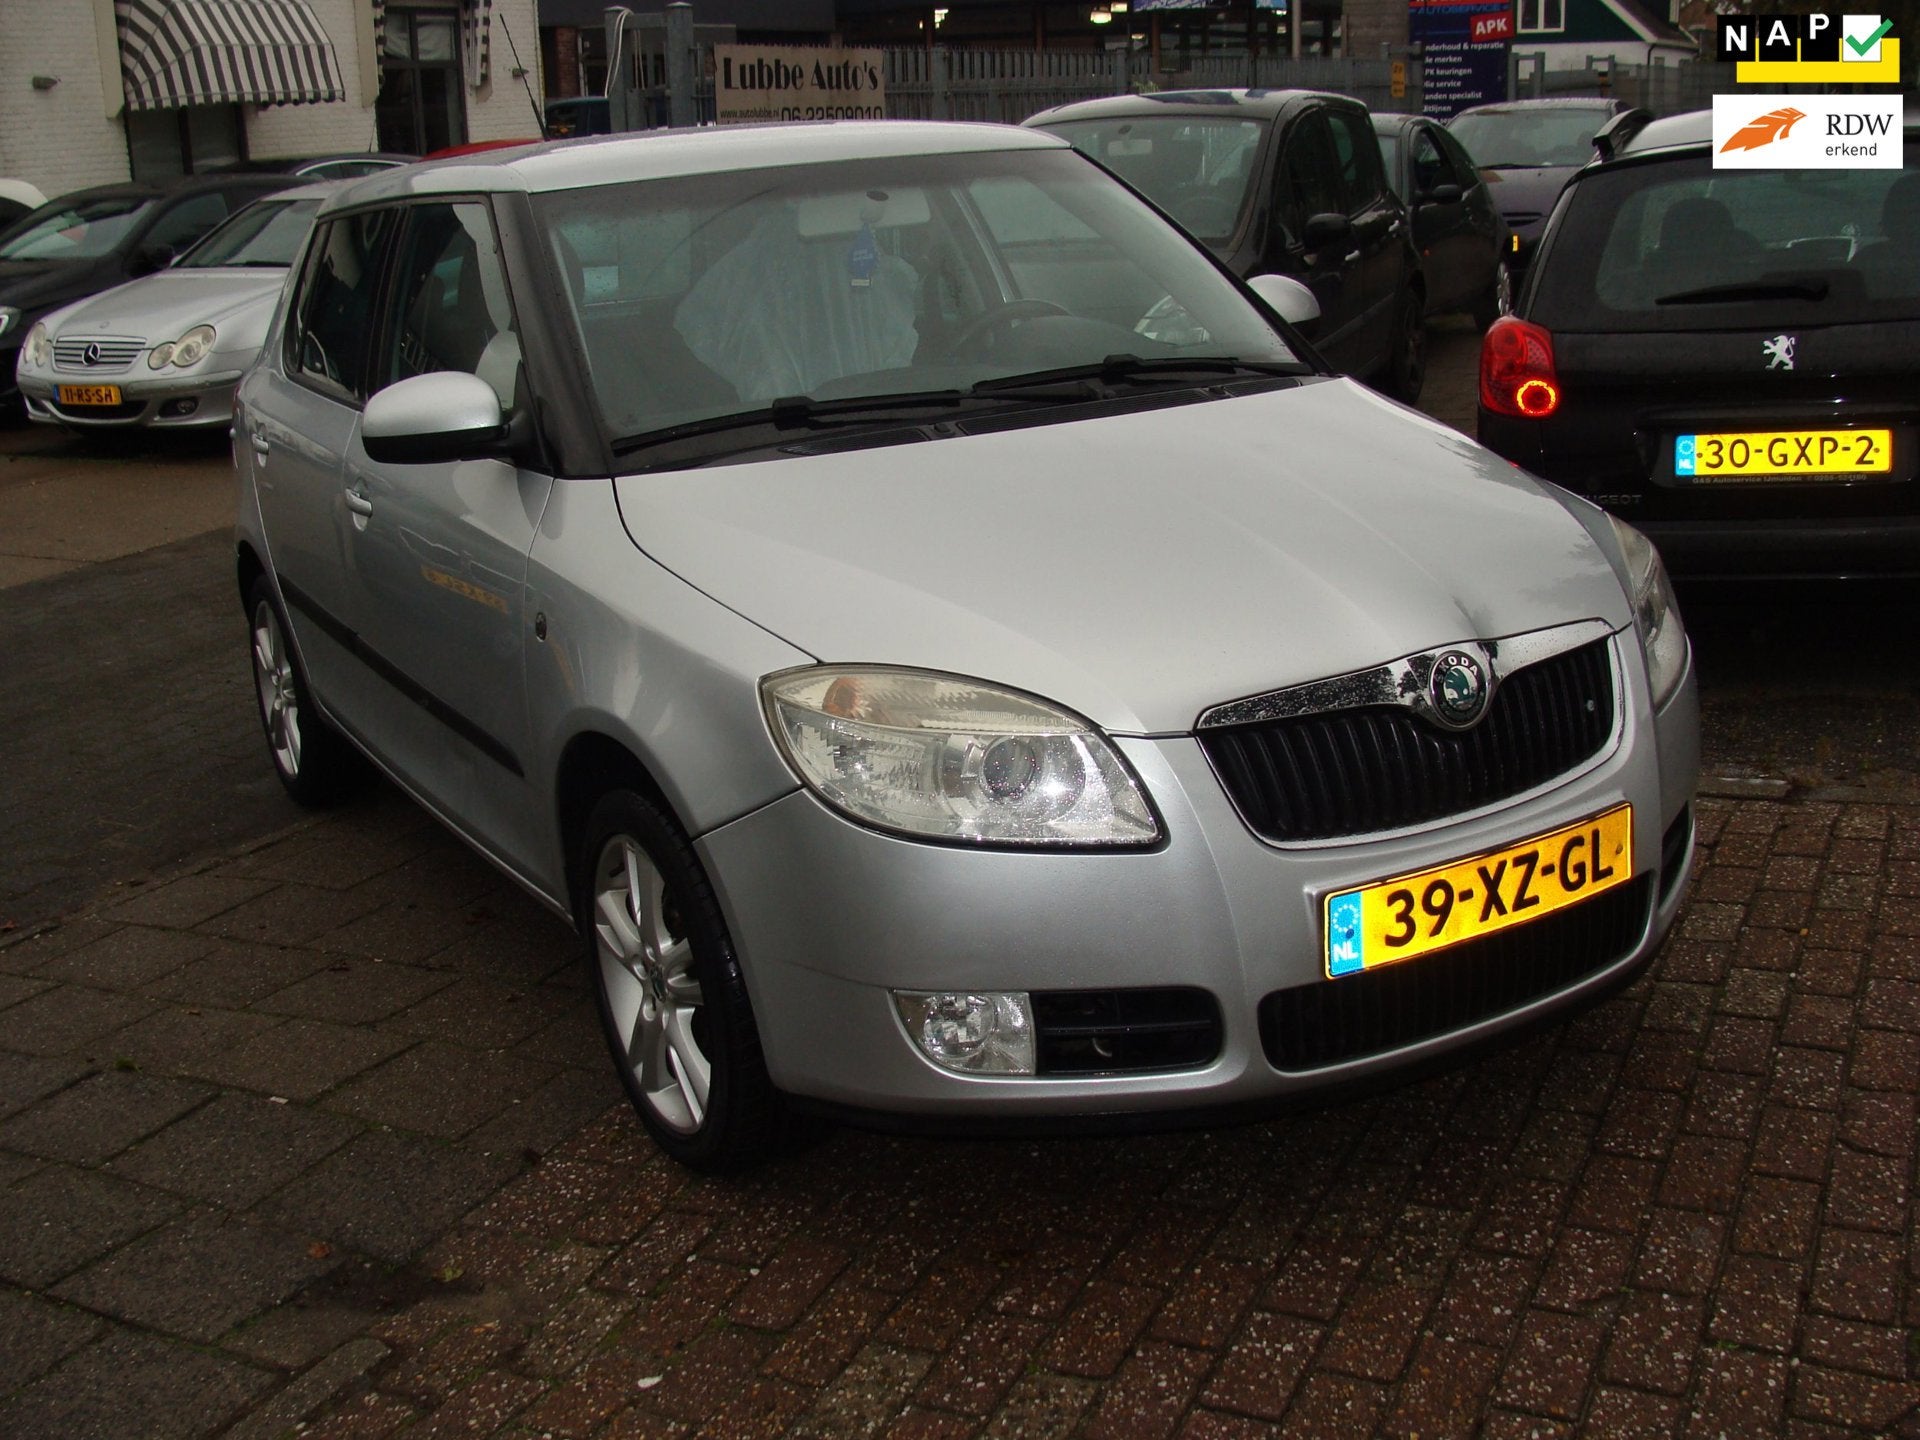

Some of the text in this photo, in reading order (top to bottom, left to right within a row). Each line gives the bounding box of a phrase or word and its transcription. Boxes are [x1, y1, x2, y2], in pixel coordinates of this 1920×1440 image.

[1475, 18, 1507, 35] APK
[1425, 43, 1461, 51] nderhoud
[1471, 42, 1504, 51] reparatie
[723, 57, 878, 91] Lubbe Auto's
[1436, 67, 1472, 76] keuringen
[1449, 91, 1482, 101] specialist
[1679, 436, 1875, 470] NL 30-GXP-2
[1333, 829, 1614, 962] NL 39-XZ-GL
